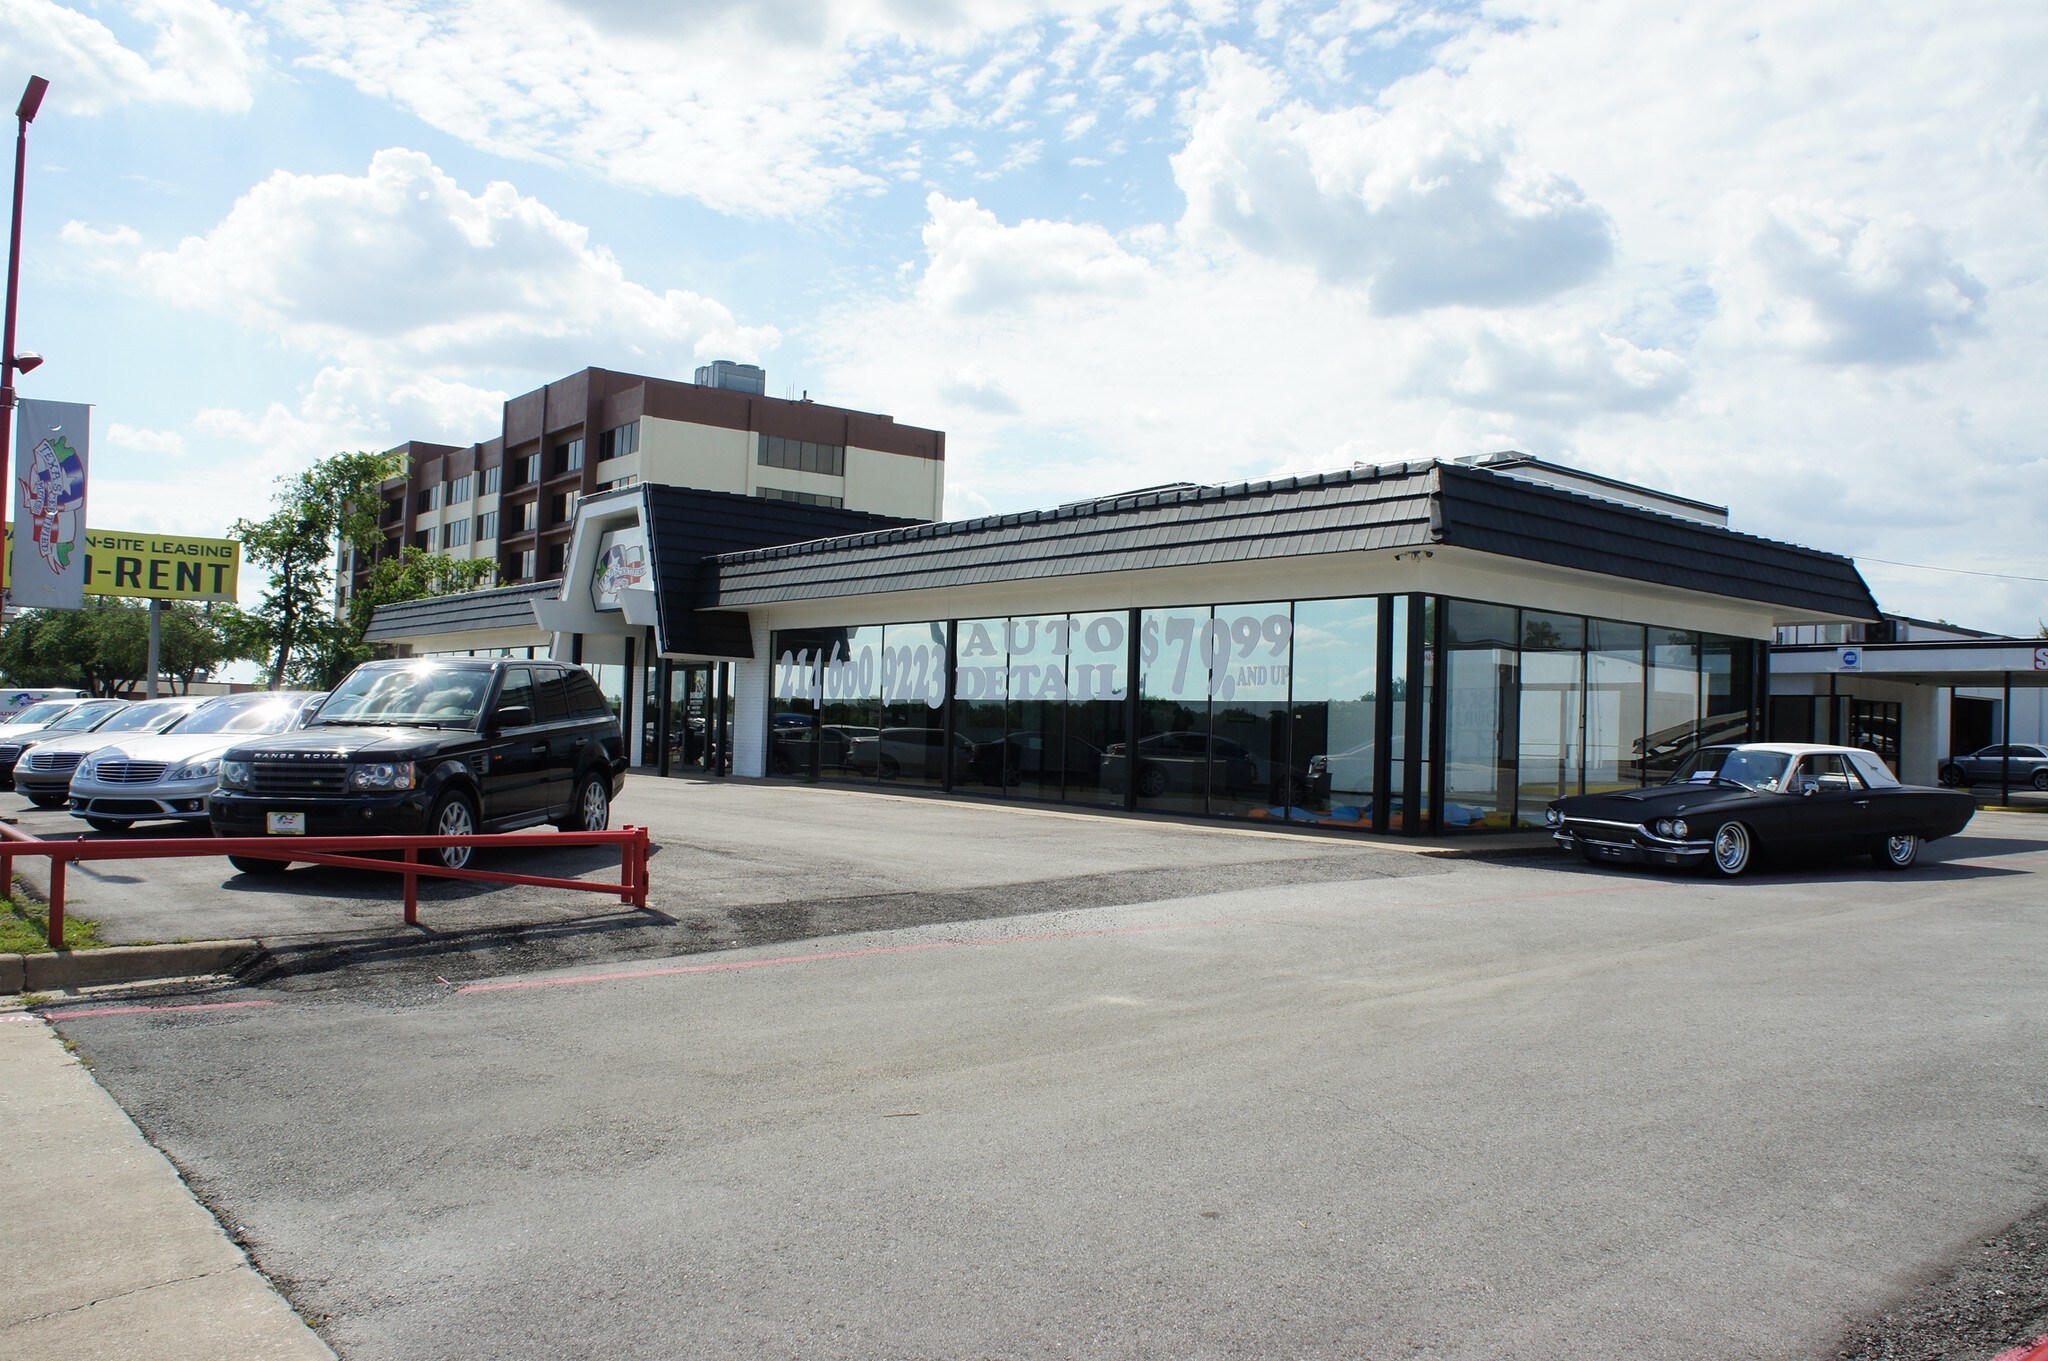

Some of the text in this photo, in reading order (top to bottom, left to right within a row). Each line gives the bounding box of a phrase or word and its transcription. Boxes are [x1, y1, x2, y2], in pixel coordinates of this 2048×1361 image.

[40, 443, 62, 493] TEXAS
[85, 536, 232, 558] N-SITE LEASING
[960, 616, 1125, 658] AUTO
[779, 647, 823, 710] 214
[882, 643, 947, 710] 9223
[953, 663, 1128, 701] DETAIL
[1236, 664, 1290, 687] AND UP
